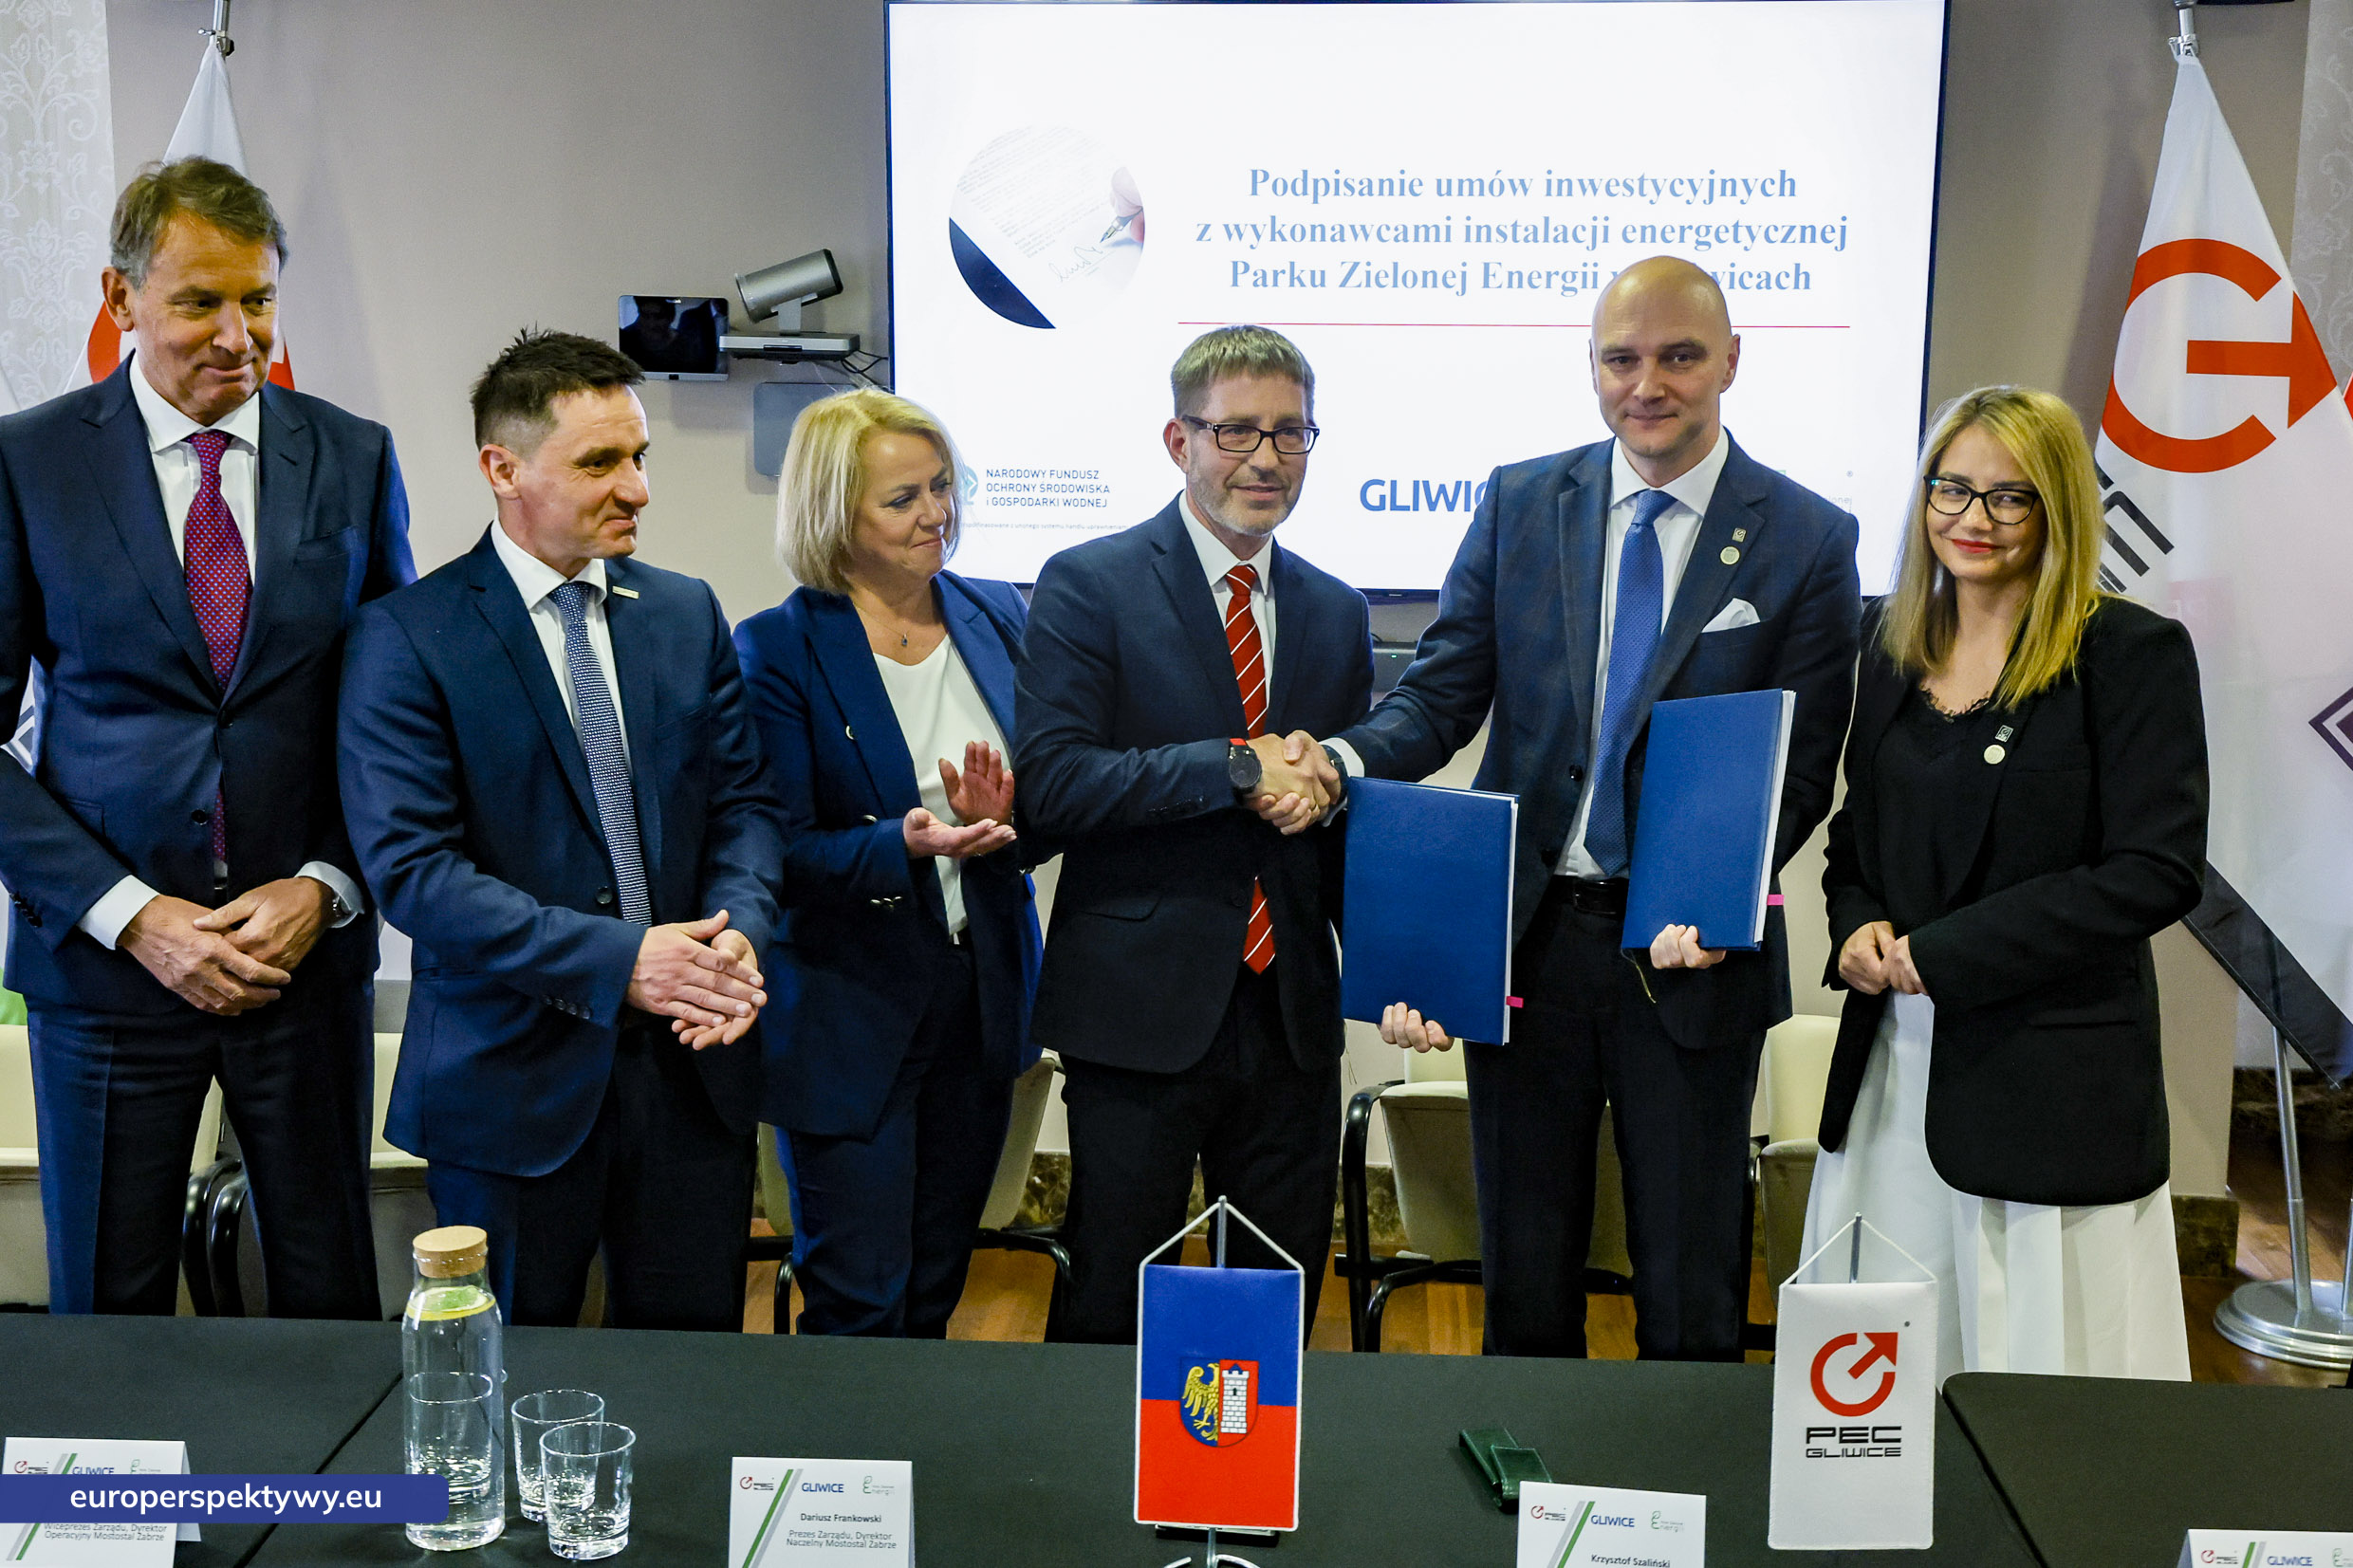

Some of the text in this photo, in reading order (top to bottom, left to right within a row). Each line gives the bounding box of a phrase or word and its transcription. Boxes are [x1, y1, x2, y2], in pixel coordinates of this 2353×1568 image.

[1249, 168, 1797, 206] Podpisanie umów inwestycyjnych
[1195, 214, 1848, 252] z wykonawcami instalacji energetycznej
[1230, 260, 1327, 289] Parku
[1338, 260, 1468, 297] Zielonej
[1480, 261, 1600, 298] Energii
[986, 469, 1100, 480] NARODOWY FUNDUSZ
[986, 482, 1110, 494] OCHRONY ŚRODOWISKA
[1360, 478, 1489, 513] GLIWI
[986, 497, 1108, 508] i GOSPODARKI WODNEJ
[1806, 1426, 1901, 1444] PEC
[1806, 1447, 1901, 1458] GLIWICE
[802, 1483, 844, 1493] GLIWICE
[801, 1513, 881, 1523] Dariusz Frankowski
[1590, 1515, 1635, 1528] GLIWICE
[131, 1524, 167, 1533] Dyrektor
[45, 1531, 91, 1540] Operacyjny
[137, 1532, 165, 1540] Zabrze
[789, 1530, 893, 1541] Prezes Zarządu, Dyrektor
[787, 1539, 897, 1549] Naczelny Mostostal Zabrze
[1591, 1554, 1671, 1568] Krzysztof Szaliński
[2267, 1556, 2313, 1567] GLIWICE
